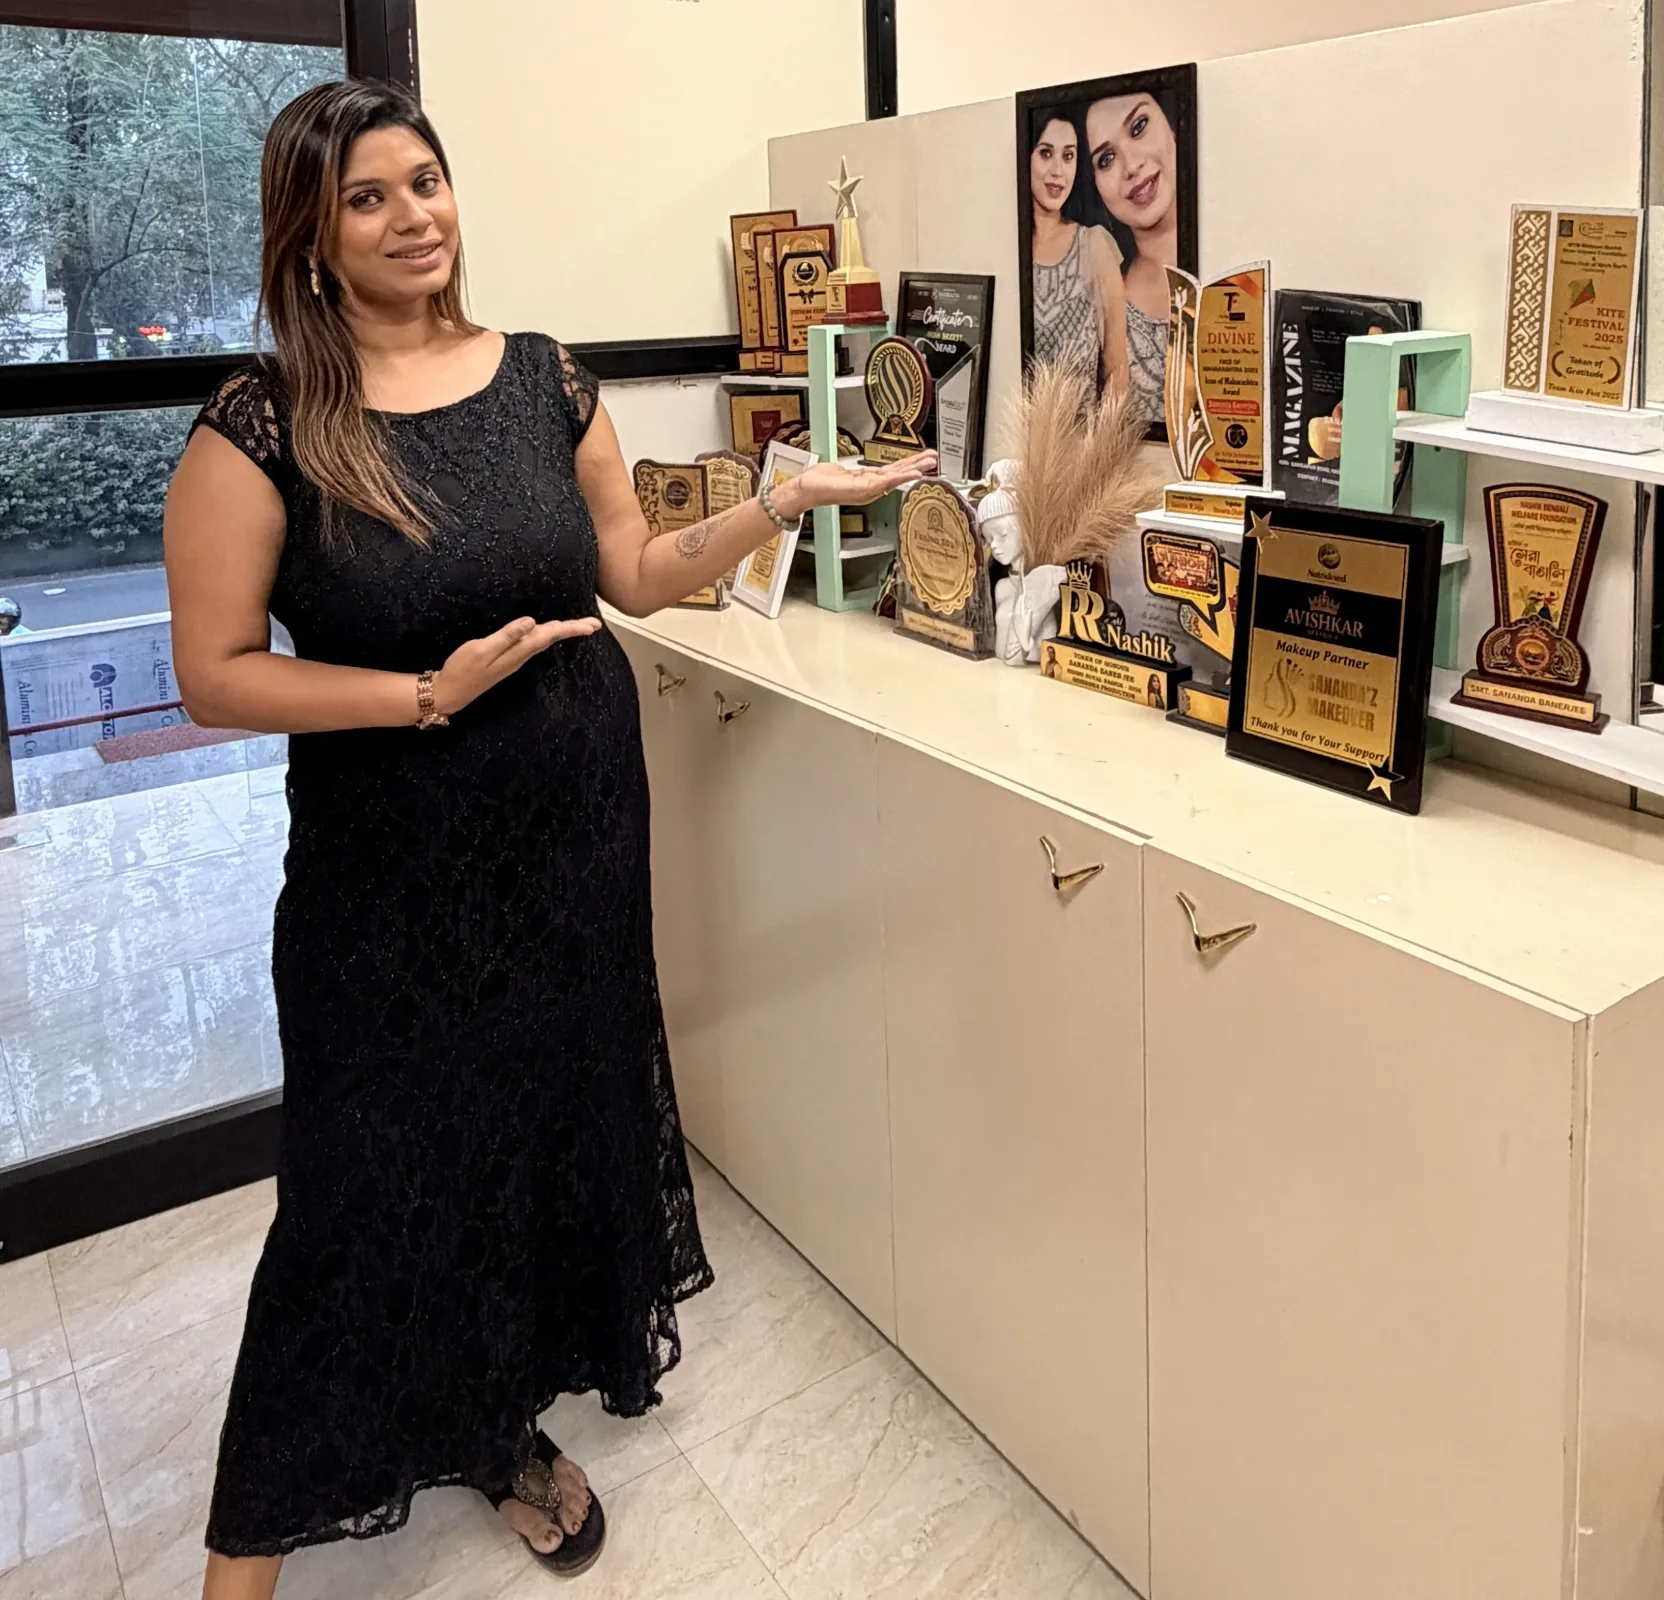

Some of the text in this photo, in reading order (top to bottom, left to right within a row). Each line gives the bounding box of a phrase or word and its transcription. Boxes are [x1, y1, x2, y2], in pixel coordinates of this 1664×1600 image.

[1597, 308, 1625, 318] KITE
[1568, 317, 1624, 331] FESTIVAL
[1207, 332, 1256, 345] DIVINE
[1594, 332, 1624, 344] 2025
[1570, 356, 1604, 368] Token of
[1566, 366, 1604, 378] Gratitude
[1282, 323, 1303, 459] MAGAZINE
[1543, 504, 1569, 514] BENGALI
[1512, 510, 1577, 524] WELFARE FOUNDATION
[1284, 608, 1364, 639] AVISHKAR
[1106, 623, 1173, 664] Nashik
[1073, 652, 1093, 662] TOKEN
[1094, 657, 1102, 665] OF
[1276, 640, 1370, 670] Makeup Partner
[1068, 660, 1098, 673] SANANDA
[1308, 672, 1378, 708] SANANDA'Z
[1470, 684, 1586, 715] SMT. SANANDA BANERJEE
[1307, 696, 1375, 732] MAKEOVER
[1250, 716, 1385, 762] Thank you for Your Support
